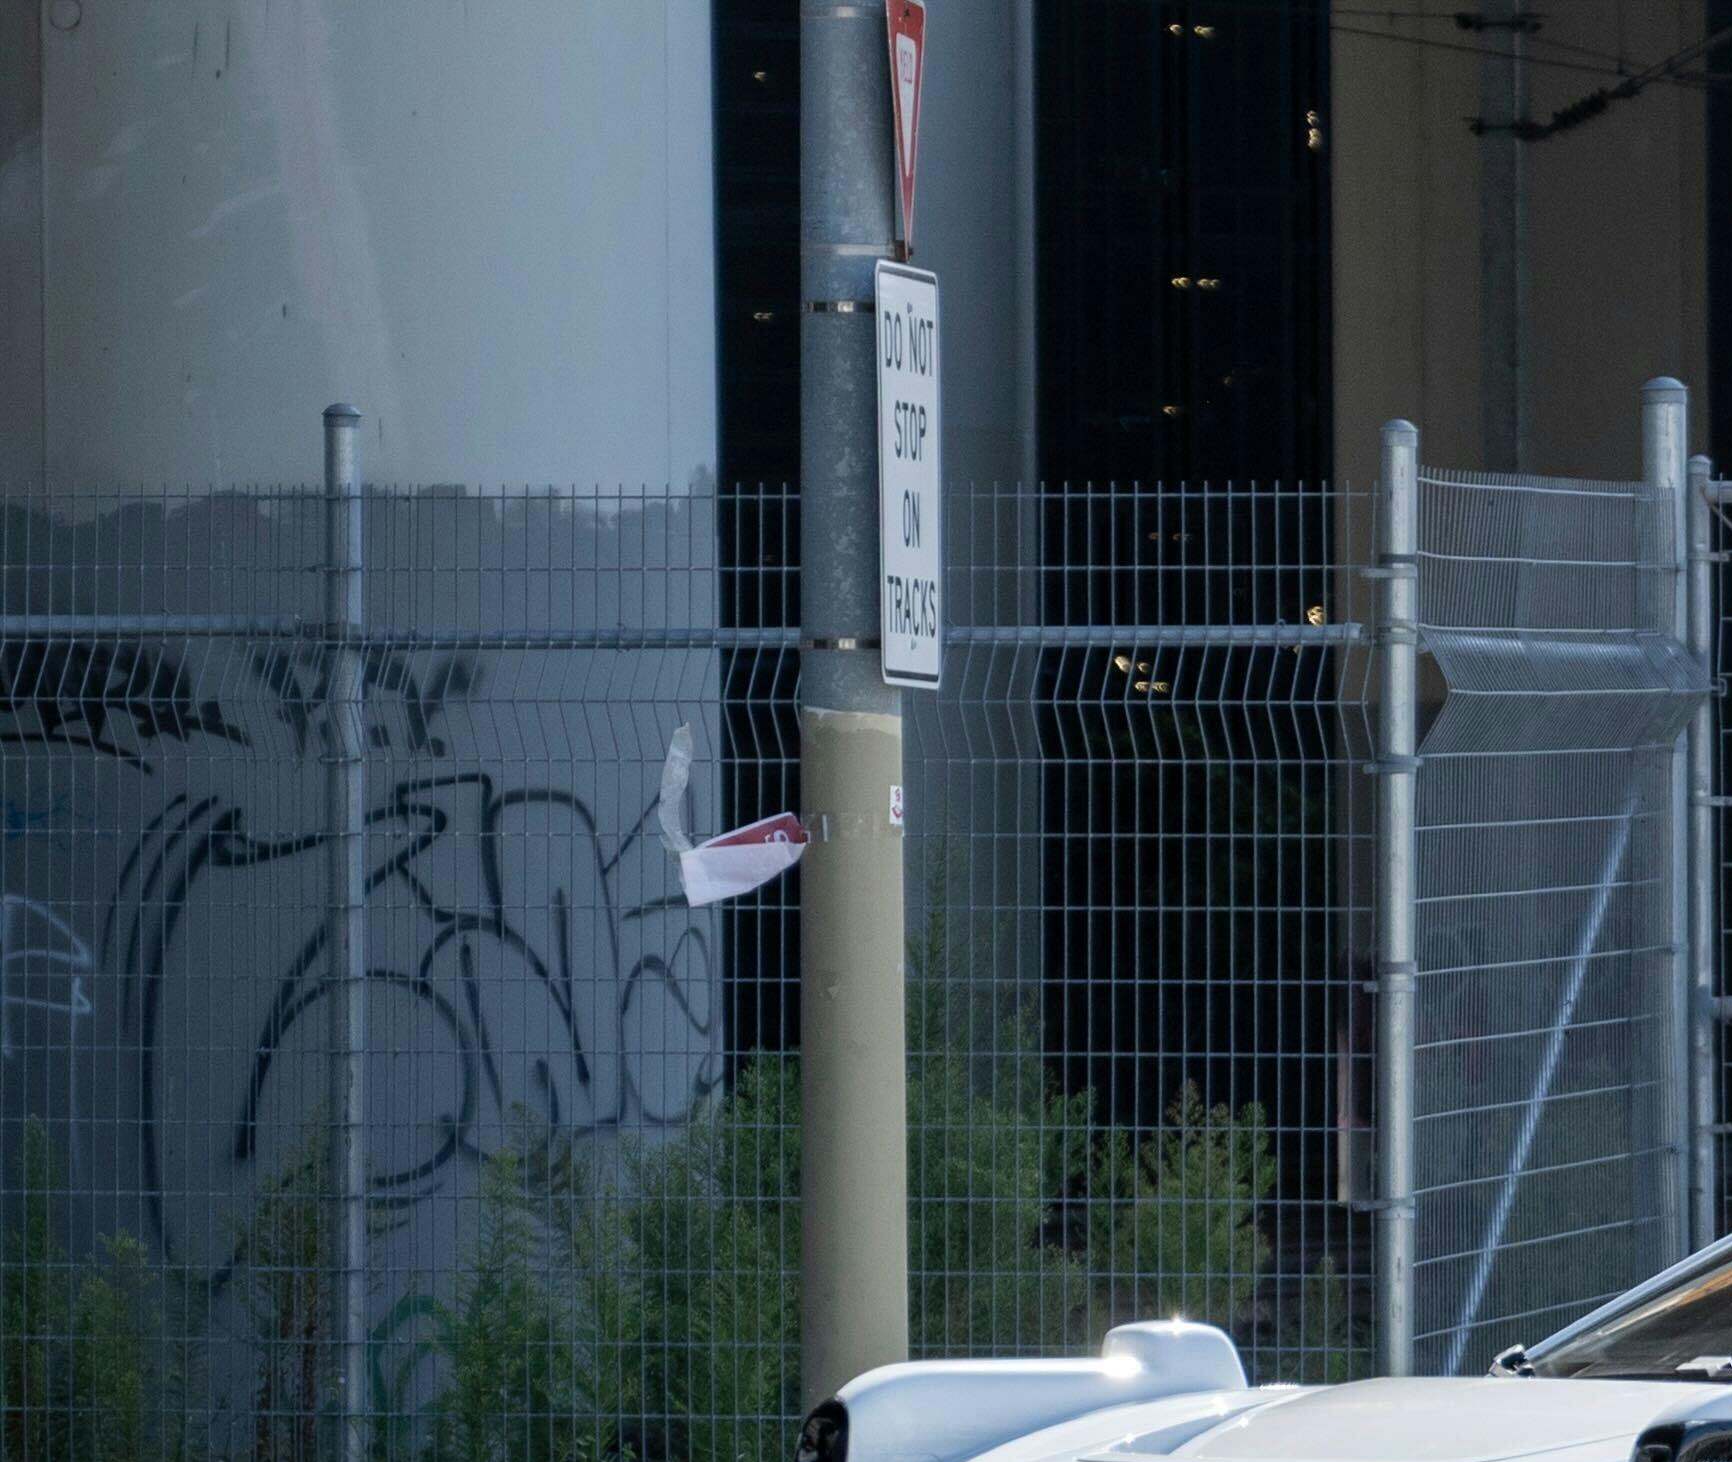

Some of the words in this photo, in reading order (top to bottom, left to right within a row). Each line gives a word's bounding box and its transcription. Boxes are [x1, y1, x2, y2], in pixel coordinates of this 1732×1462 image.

[884, 310, 902, 371] DO
[909, 316, 934, 377] NOT
[894, 399, 927, 462] STOP
[903, 489, 921, 549] ON
[887, 574, 937, 639] TRACKS
